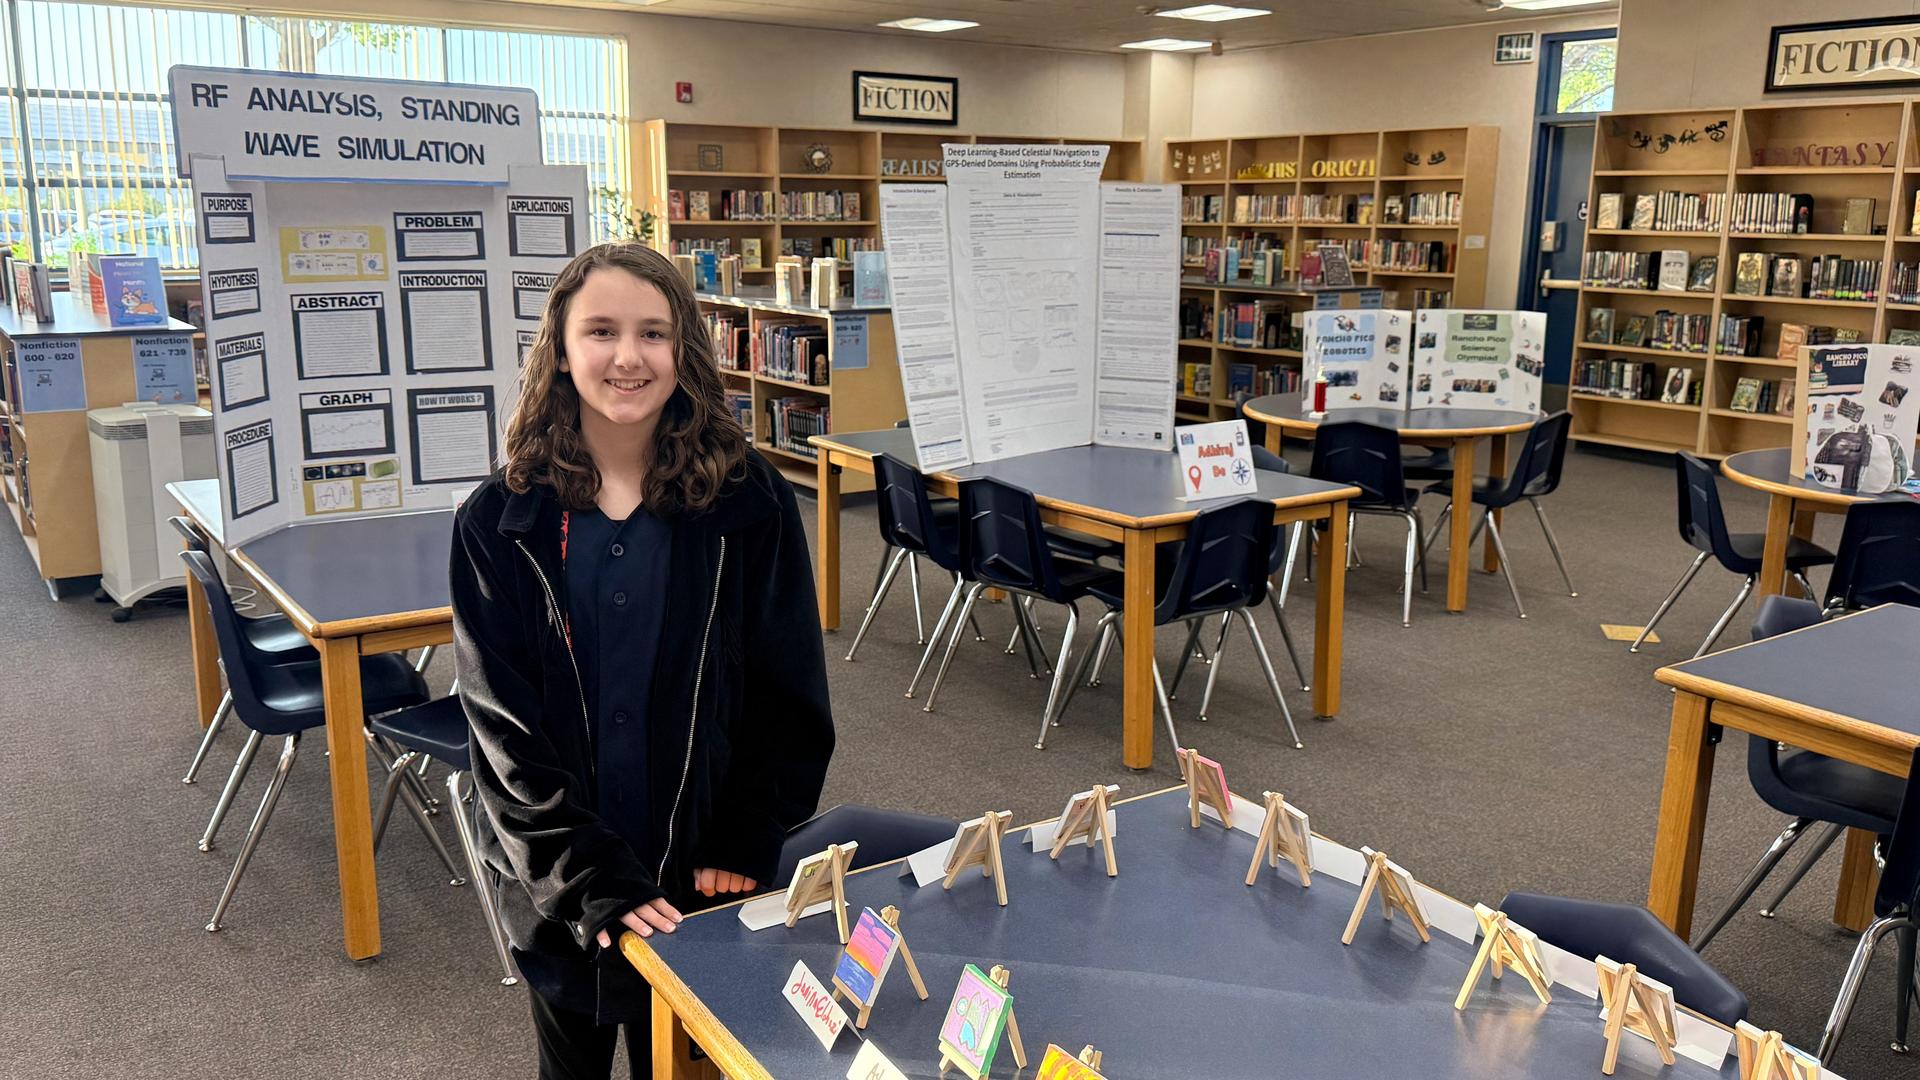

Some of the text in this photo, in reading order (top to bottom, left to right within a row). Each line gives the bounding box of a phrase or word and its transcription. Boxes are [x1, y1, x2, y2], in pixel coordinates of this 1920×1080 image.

[191, 83, 520, 126] RF ANALYSIS, STANDING
[861, 86, 950, 113] FICTION
[245, 131, 484, 165] WAVE SIMULATION
[948, 148, 966, 157] Deep
[968, 147, 1020, 157] Learning-Based
[1022, 148, 1051, 156] Celestial
[1053, 148, 1090, 158] Navigation
[1020, 160, 1039, 169] Using
[207, 198, 248, 212] PURPOSE
[511, 201, 570, 213] APPLICATIONS
[405, 215, 474, 229] PROBLEM
[211, 273, 257, 290] HYPOTHESIS
[403, 274, 483, 288] INTRODUCTION
[297, 295, 378, 309] ABSTRACT
[20, 341, 77, 350] Nonfiction
[135, 337, 189, 346] Nonfiction
[219, 337, 262, 358] MATERIALS
[24, 354, 45, 362] 600
[54, 353, 75, 361] 620
[139, 350, 159, 358] 621
[1456, 354, 1498, 362] Olympiad
[320, 393, 373, 406] GRAPH
[419, 396, 438, 406] HOW
[439, 396, 446, 404] IT
[448, 395, 476, 404] WORKS
[227, 425, 270, 447] PROCEDURE
